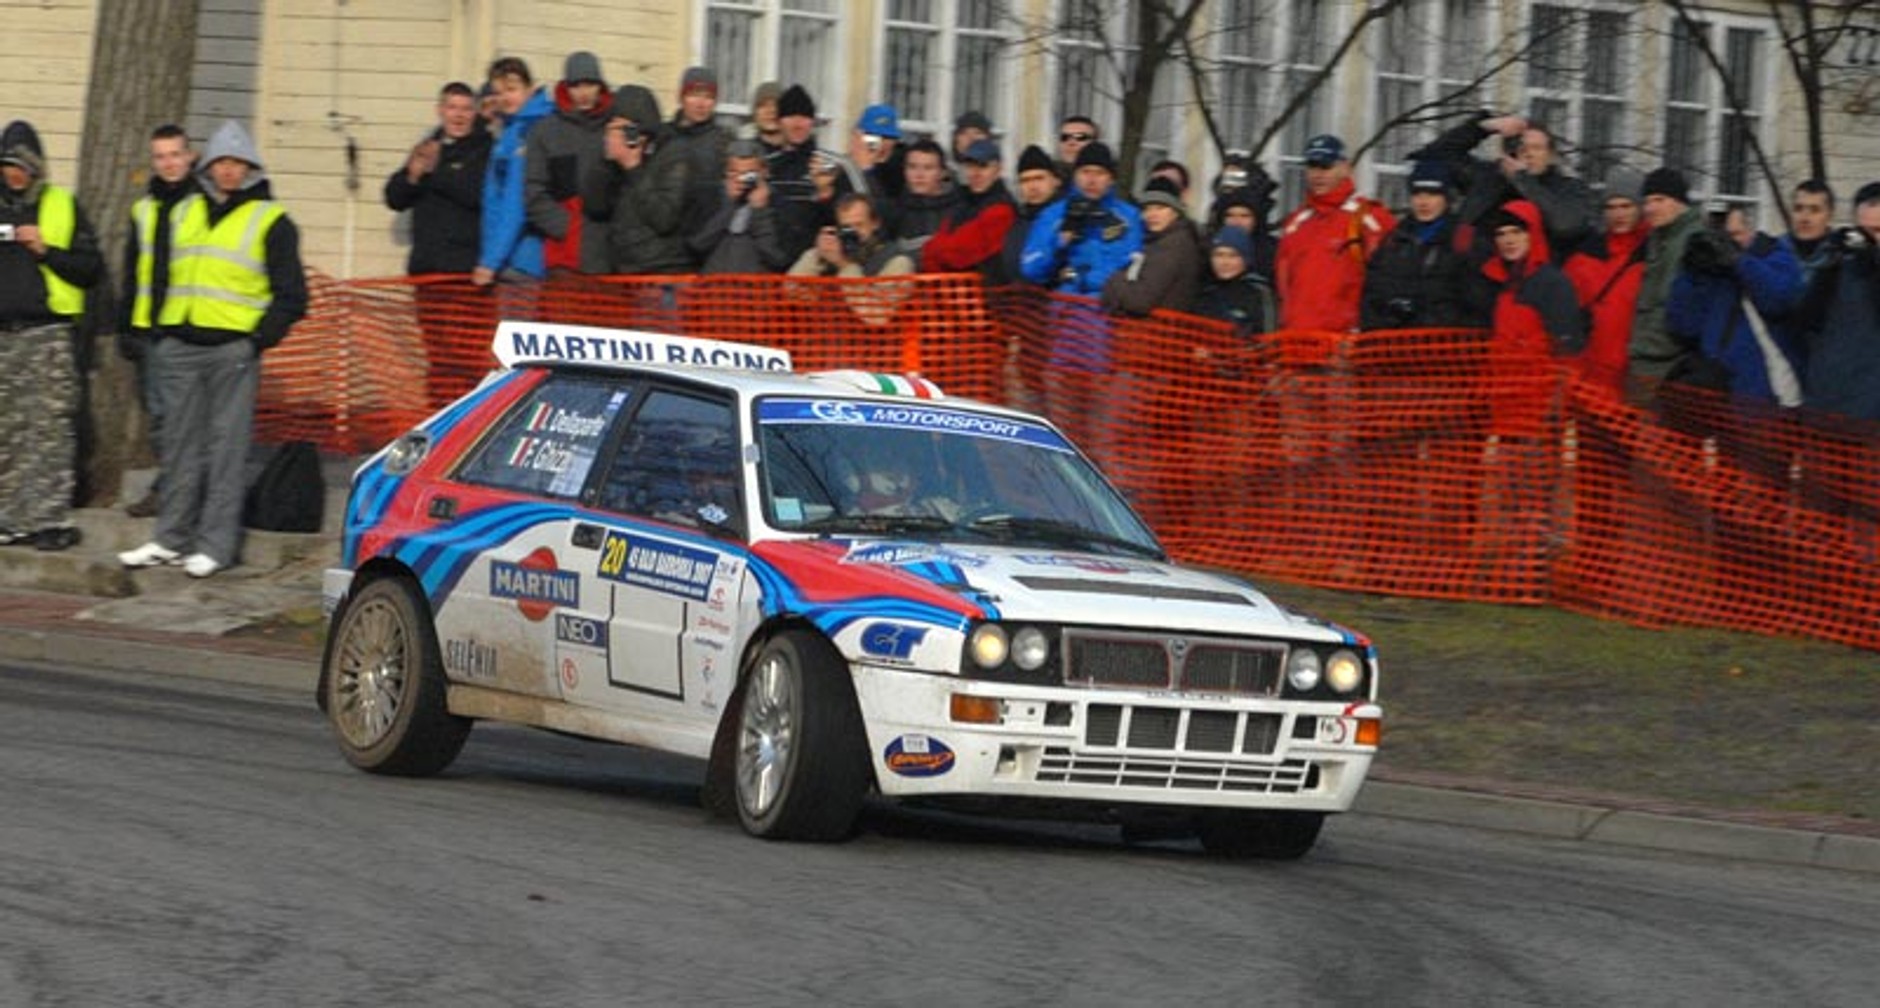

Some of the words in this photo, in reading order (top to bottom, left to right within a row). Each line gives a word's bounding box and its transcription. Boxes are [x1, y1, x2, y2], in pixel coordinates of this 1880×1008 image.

[511, 332, 654, 362] MARTINI
[666, 344, 786, 371] RACING
[872, 407, 1024, 436] MOTORSPORT
[600, 535, 628, 575] 20
[495, 567, 577, 604] MARTINI
[558, 616, 597, 643] NEO
